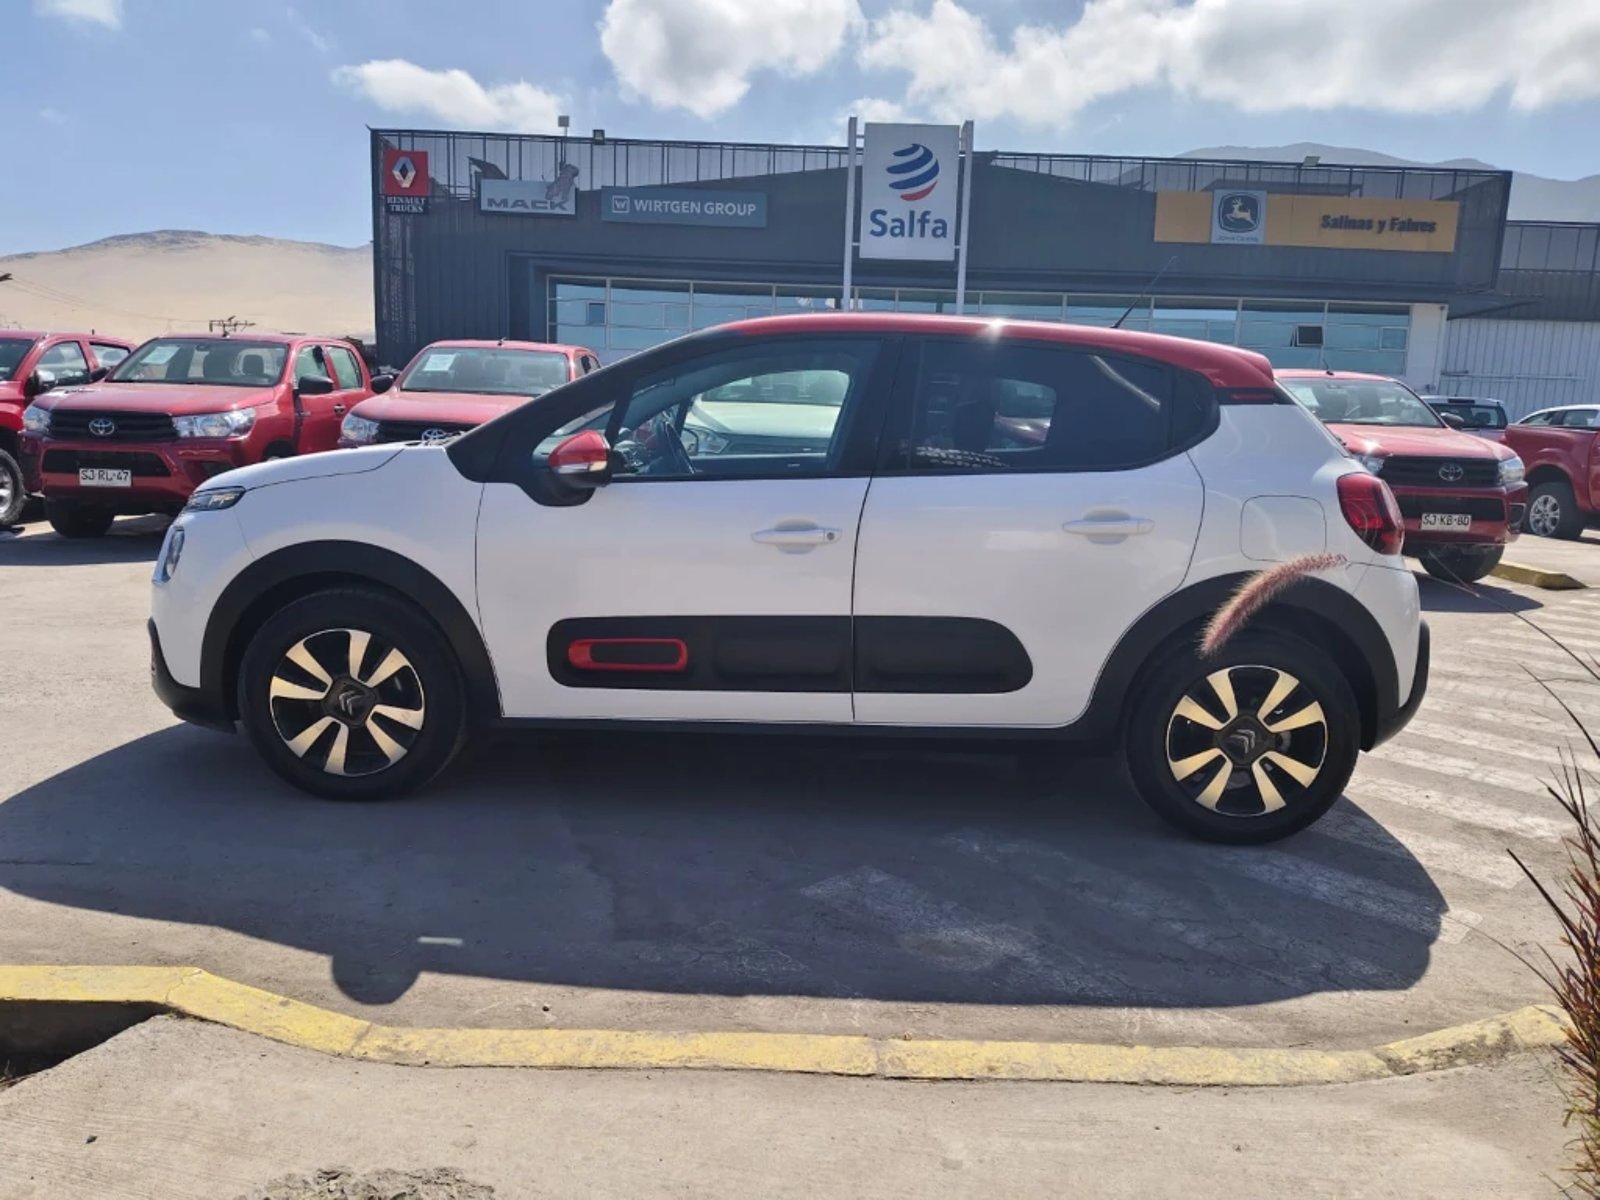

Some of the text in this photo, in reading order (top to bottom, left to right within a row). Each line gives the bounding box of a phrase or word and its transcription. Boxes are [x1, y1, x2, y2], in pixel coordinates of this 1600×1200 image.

[487, 198, 568, 211] MACK
[634, 199, 700, 213] WIRTGEN
[704, 202, 756, 216] GROUP
[869, 208, 948, 239] Salfa
[1321, 214, 1374, 231] Salinas
[1377, 220, 1387, 235] y
